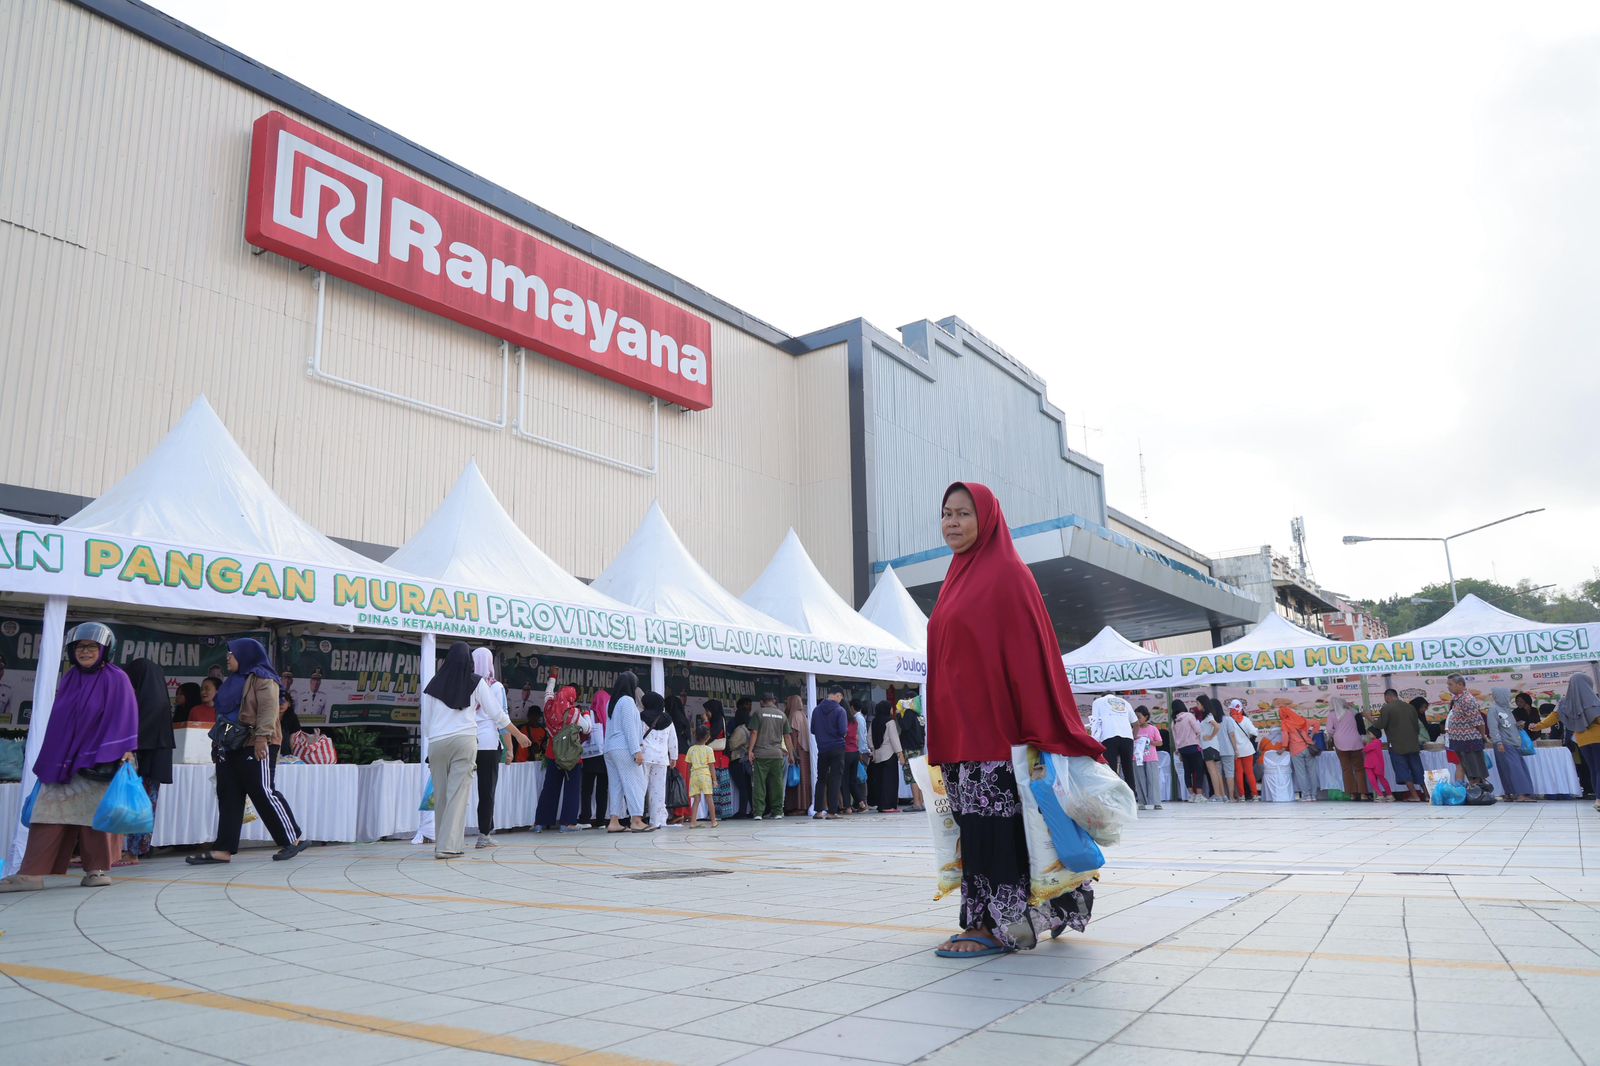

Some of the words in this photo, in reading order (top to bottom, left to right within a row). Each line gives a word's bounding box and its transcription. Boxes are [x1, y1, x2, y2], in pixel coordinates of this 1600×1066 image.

[389, 197, 708, 385] Ramayana
[85, 538, 316, 603] PANGAN
[334, 573, 479, 622] MURAH
[487, 596, 637, 641] PROVINSI
[645, 618, 783, 658] KEPULAUAN
[788, 638, 833, 663] RIAU
[838, 644, 879, 669] 2025
[358, 612, 399, 626] DINAS
[403, 617, 476, 635] KETAHANAN
[479, 626, 526, 640] PANGAN,
[529, 632, 583, 647] PERTANIAN
[586, 639, 605, 649] DAN
[607, 641, 656, 655] KESEHATAN
[658, 647, 687, 658] HEWAN
[120, 639, 200, 666] PANGAN
[330, 649, 394, 673] GERAKAN
[1181, 648, 1295, 677] PANGAN
[1305, 641, 1414, 668] MURAH
[1421, 627, 1590, 661] PROVINSI
[902, 656, 927, 676] bulog
[1323, 666, 1350, 675] DINAS
[1353, 663, 1412, 673] KETAHANAN
[1416, 660, 1460, 670] PANGAN,
[1462, 656, 1521, 667] PERTANIAN
[1526, 654, 1549, 663] DAN
[357, 671, 418, 694] MURAH
[536, 665, 584, 687] GEAKAN
[586, 669, 621, 689] PANGA
[688, 675, 725, 693] GERAKAN
[726, 678, 756, 697] PANGAN
